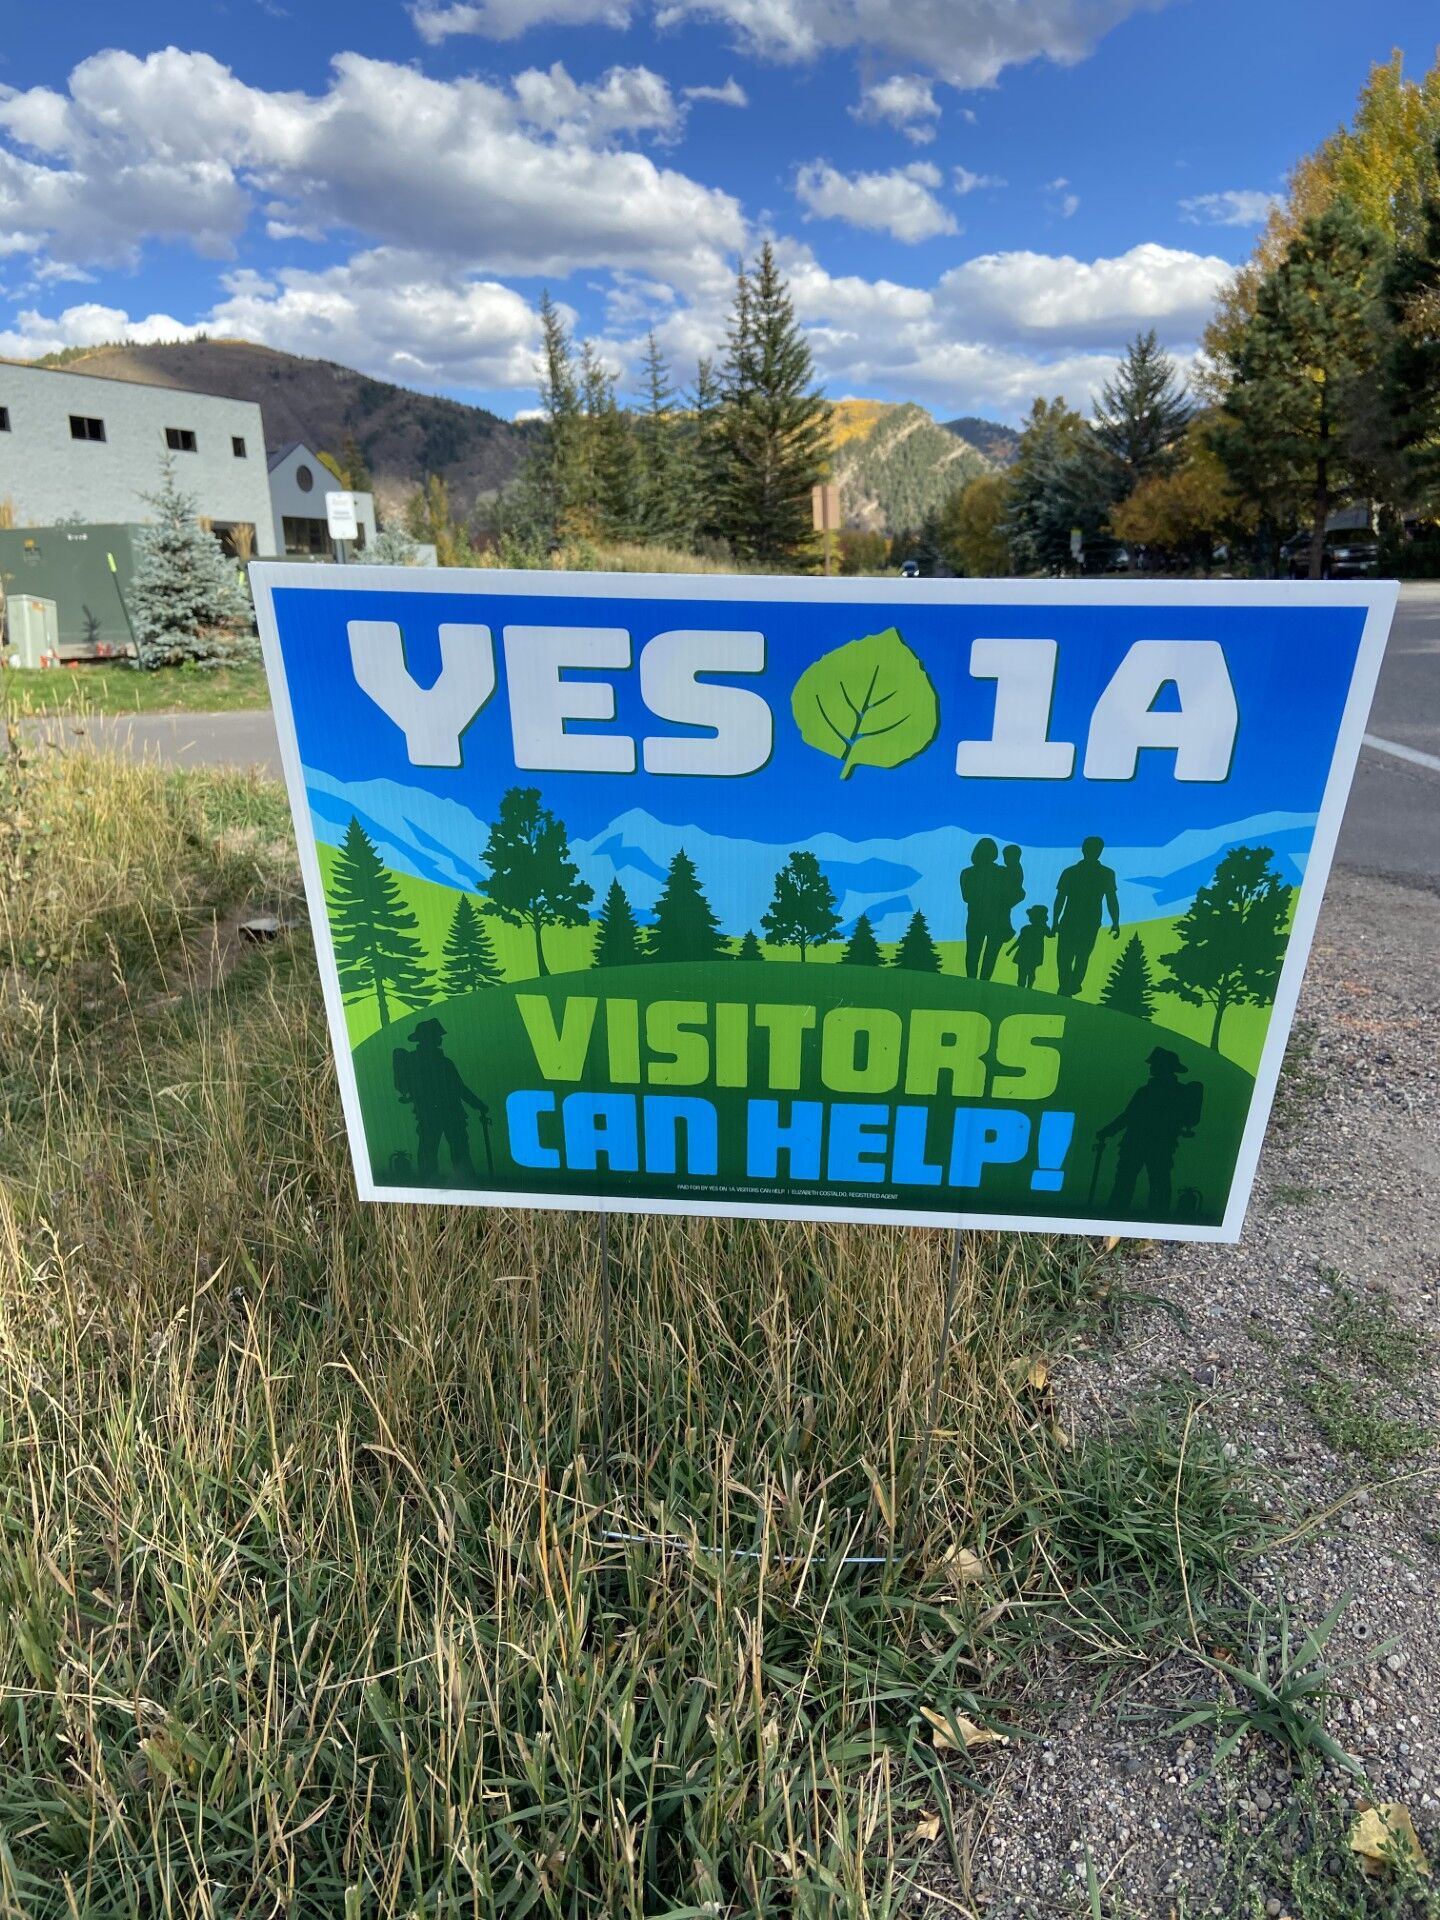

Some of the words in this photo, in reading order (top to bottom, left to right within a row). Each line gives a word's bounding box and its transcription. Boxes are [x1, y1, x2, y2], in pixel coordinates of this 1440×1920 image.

[347, 620, 774, 777] YES
[955, 638, 1240, 782] 1A
[515, 994, 1067, 1100] VISITORS
[506, 1090, 718, 1176] CAN
[746, 1099, 1076, 1191] HELP!
